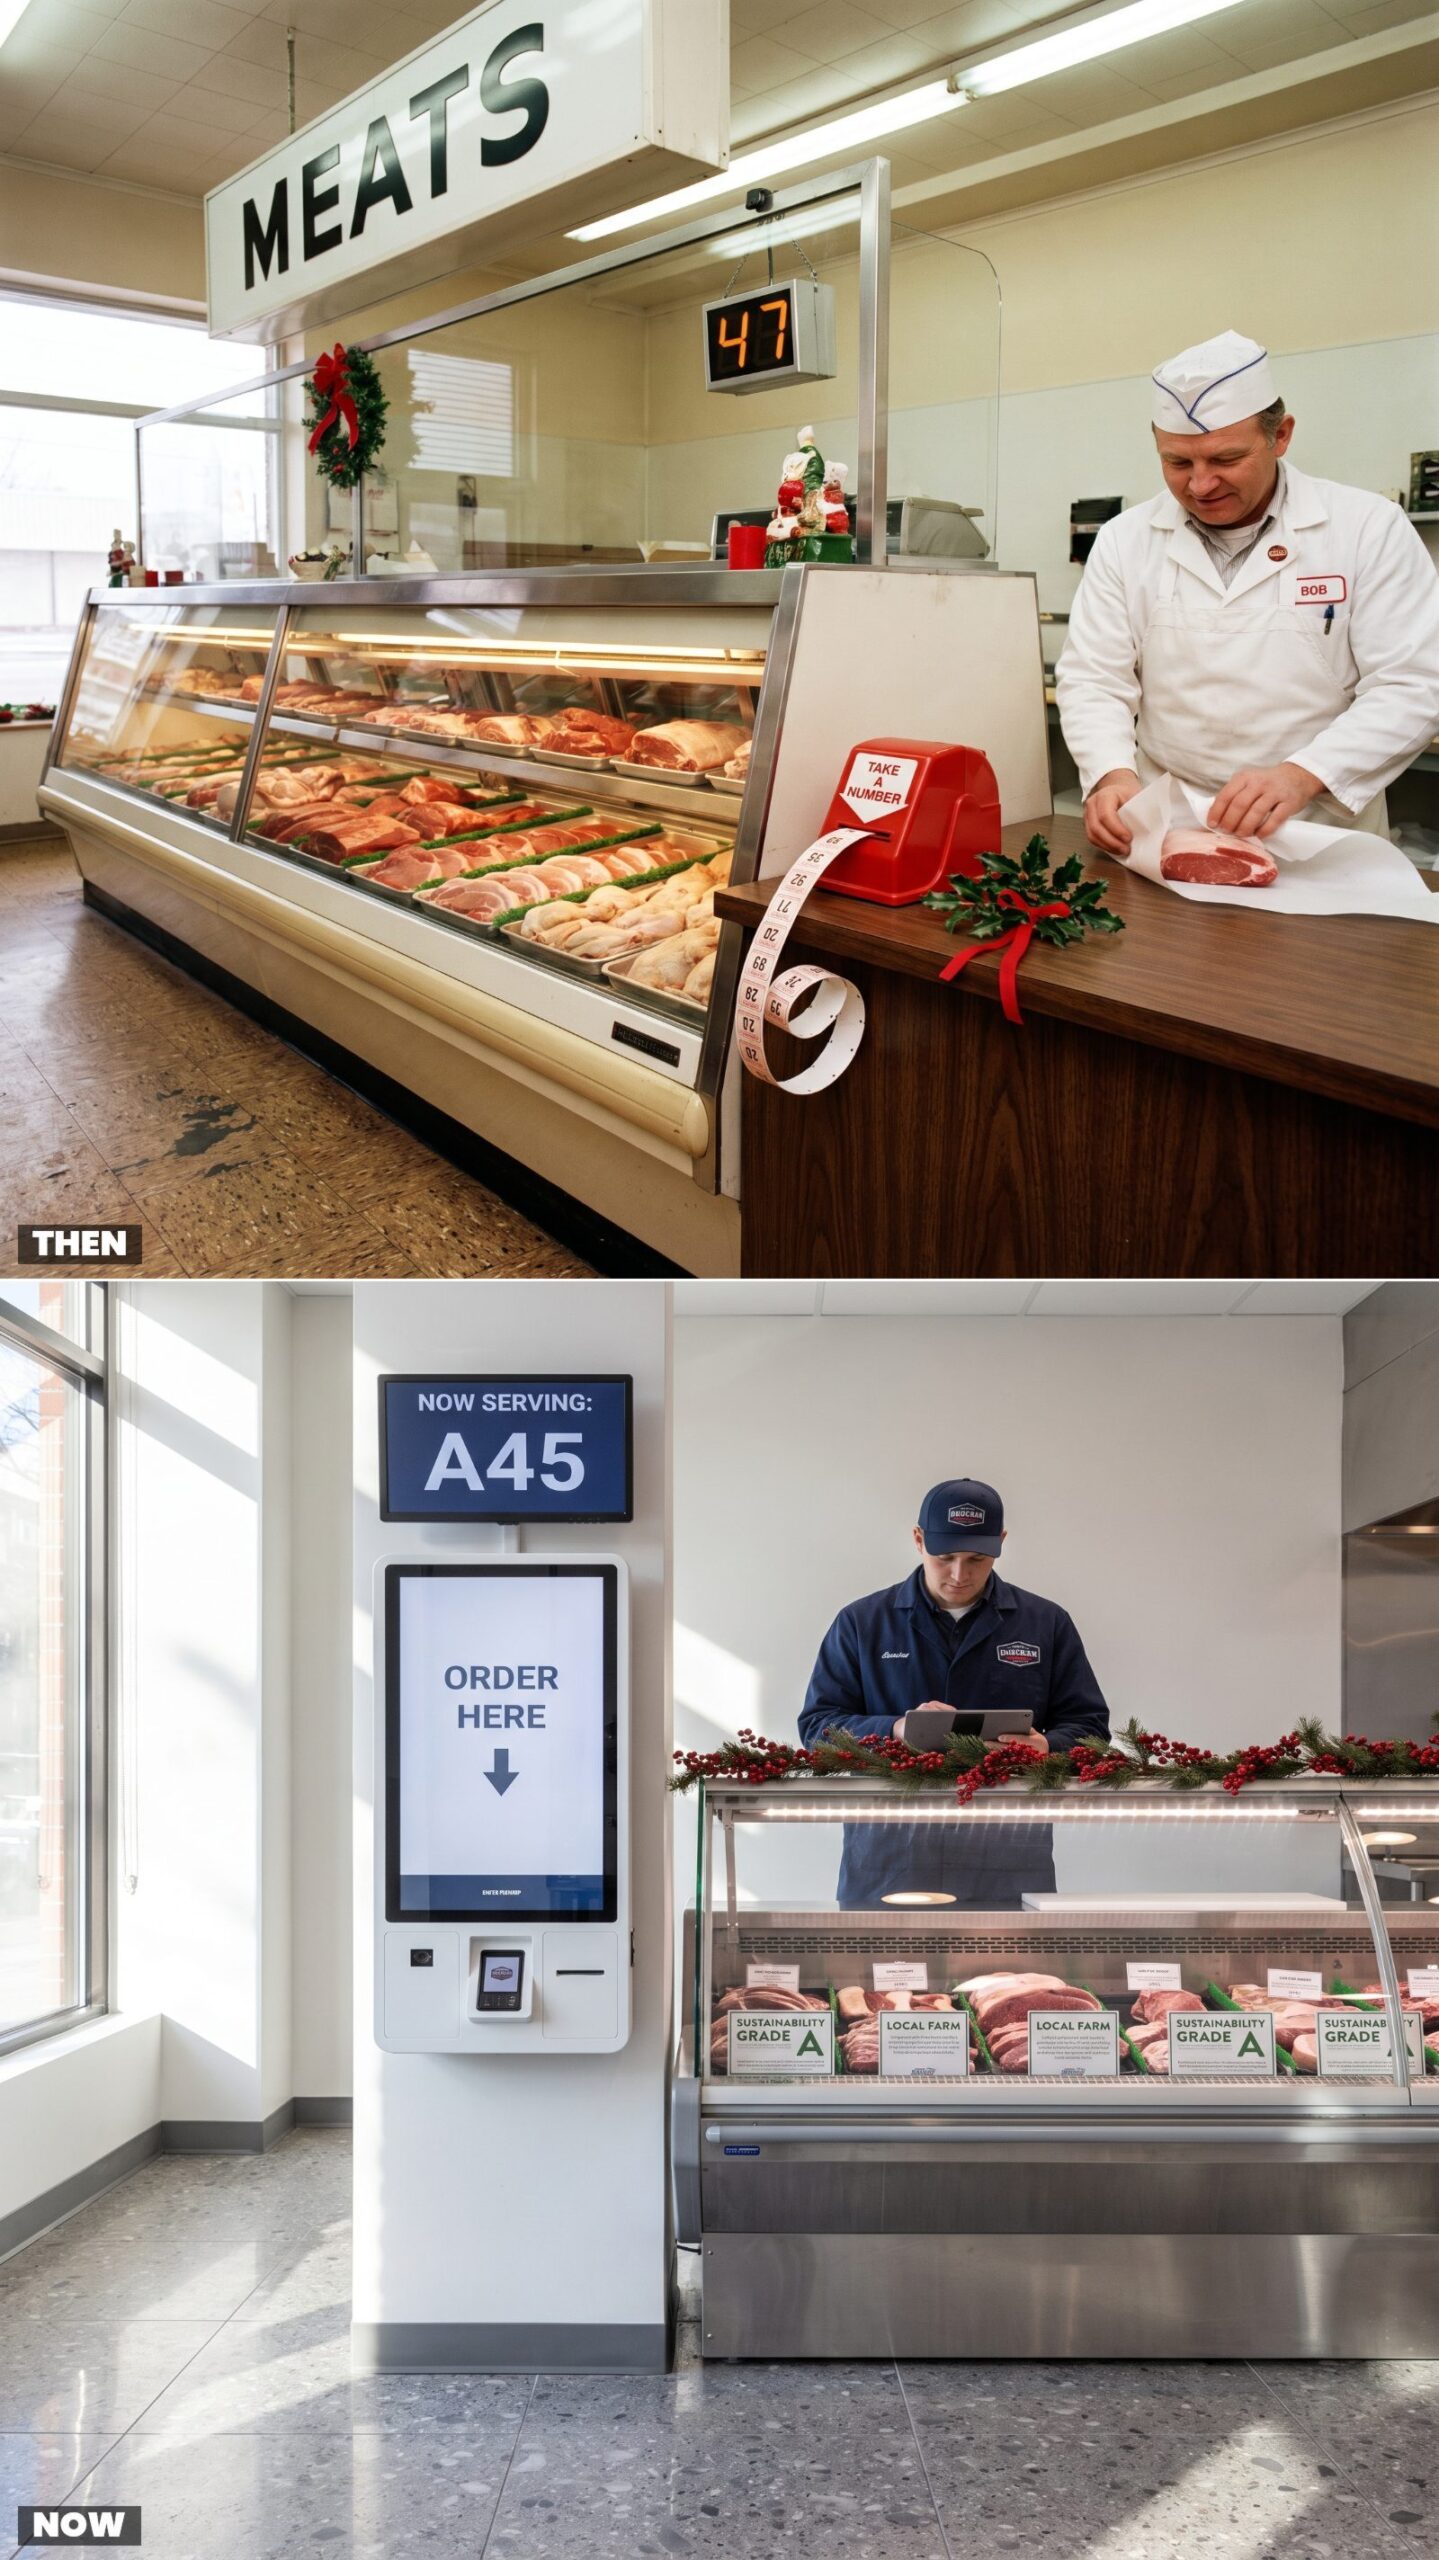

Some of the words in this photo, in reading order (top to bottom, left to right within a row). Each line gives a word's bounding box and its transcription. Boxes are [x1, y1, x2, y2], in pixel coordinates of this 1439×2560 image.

[243, 23, 550, 291] MEATS
[718, 299, 788, 369] 47
[1300, 584, 1328, 597] BOB
[868, 761, 901, 777] TAKE
[873, 777, 884, 788] A
[847, 788, 902, 806] NUMBER
[418, 1393, 475, 1412] NOW
[482, 1393, 593, 1413] SERVING:
[424, 1432, 586, 1492] A45
[444, 1665, 559, 1690] ORDER
[458, 1704, 546, 1729] HERE
[736, 2018, 825, 2028] SUSTAINABILITY
[887, 2021, 925, 2031] LOCAL
[928, 2021, 961, 2031] FARM
[1036, 2021, 1075, 2031] LOCAL
[1077, 2021, 1111, 2031] FARM
[1176, 2019, 1265, 2029] SUSTAINABILITY
[736, 2029, 791, 2042] GRADE
[796, 2029, 825, 2057] A
[1176, 2030, 1232, 2043] GRADE
[1237, 2030, 1265, 2058] A
[1324, 2030, 1381, 2043] GRADE
